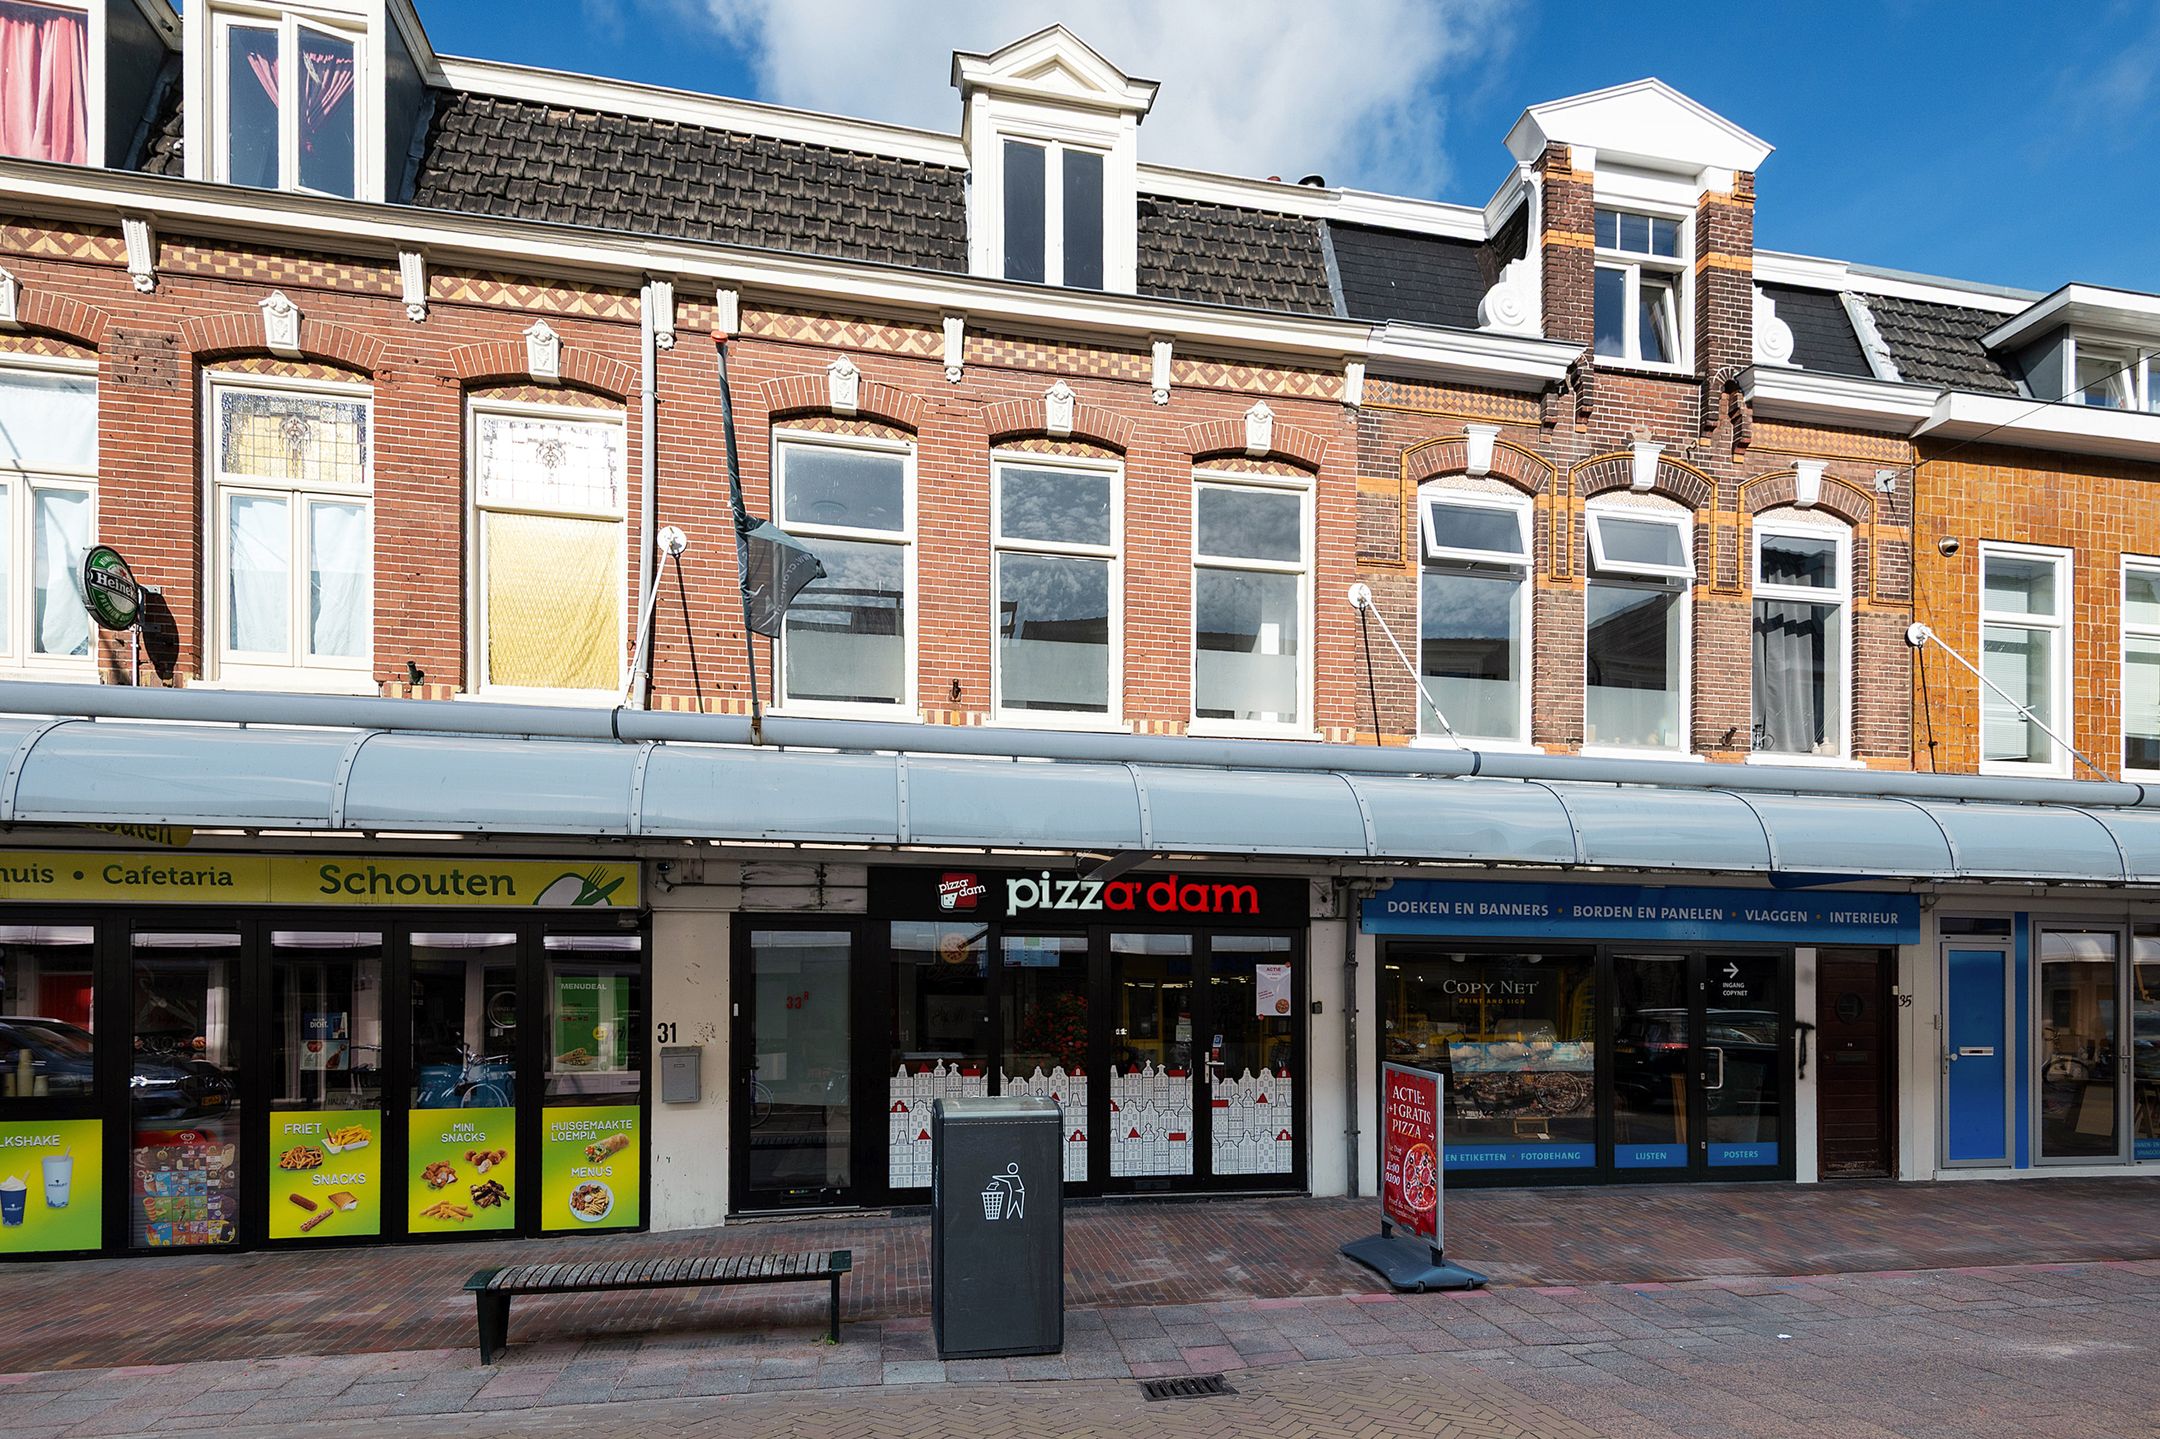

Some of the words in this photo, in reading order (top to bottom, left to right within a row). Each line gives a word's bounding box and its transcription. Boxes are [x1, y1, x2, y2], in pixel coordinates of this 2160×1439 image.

[102, 864, 234, 886] Cafetaria
[319, 864, 516, 896] Schouten
[958, 883, 987, 898] dam
[1387, 901, 1449, 914] DOEKEN
[1455, 903, 1474, 915] EN
[1479, 903, 1549, 917] BANNERS
[1573, 905, 1633, 918] BORDEN
[1638, 907, 1656, 919] EN
[1661, 907, 1723, 920] PANELEN
[1745, 909, 1808, 923] VLAGGEN
[1829, 911, 1898, 924] INTERIEUR
[1898, 995, 1912, 1008] 35
[657, 1022, 677, 1043] 31
[1392, 1085, 1425, 1106] ACTIE:
[1398, 1104, 1431, 1125] GRATIS
[284, 1122, 322, 1135] FRIET
[452, 1122, 475, 1133] MINI
[551, 1120, 633, 1131] HUISGEMAAKTE
[1392, 1118, 1422, 1140] PIZZA
[440, 1132, 486, 1143] SNACKS
[551, 1131, 597, 1142] LOEMPIA
[1460, 1153, 1507, 1161] ETIKETTEN
[1521, 1152, 1581, 1160] FOTOBEHANG
[1635, 1152, 1667, 1160] LIJSTEN
[1723, 1150, 1758, 1158] POSTERS
[312, 1172, 367, 1186] SNACKS
